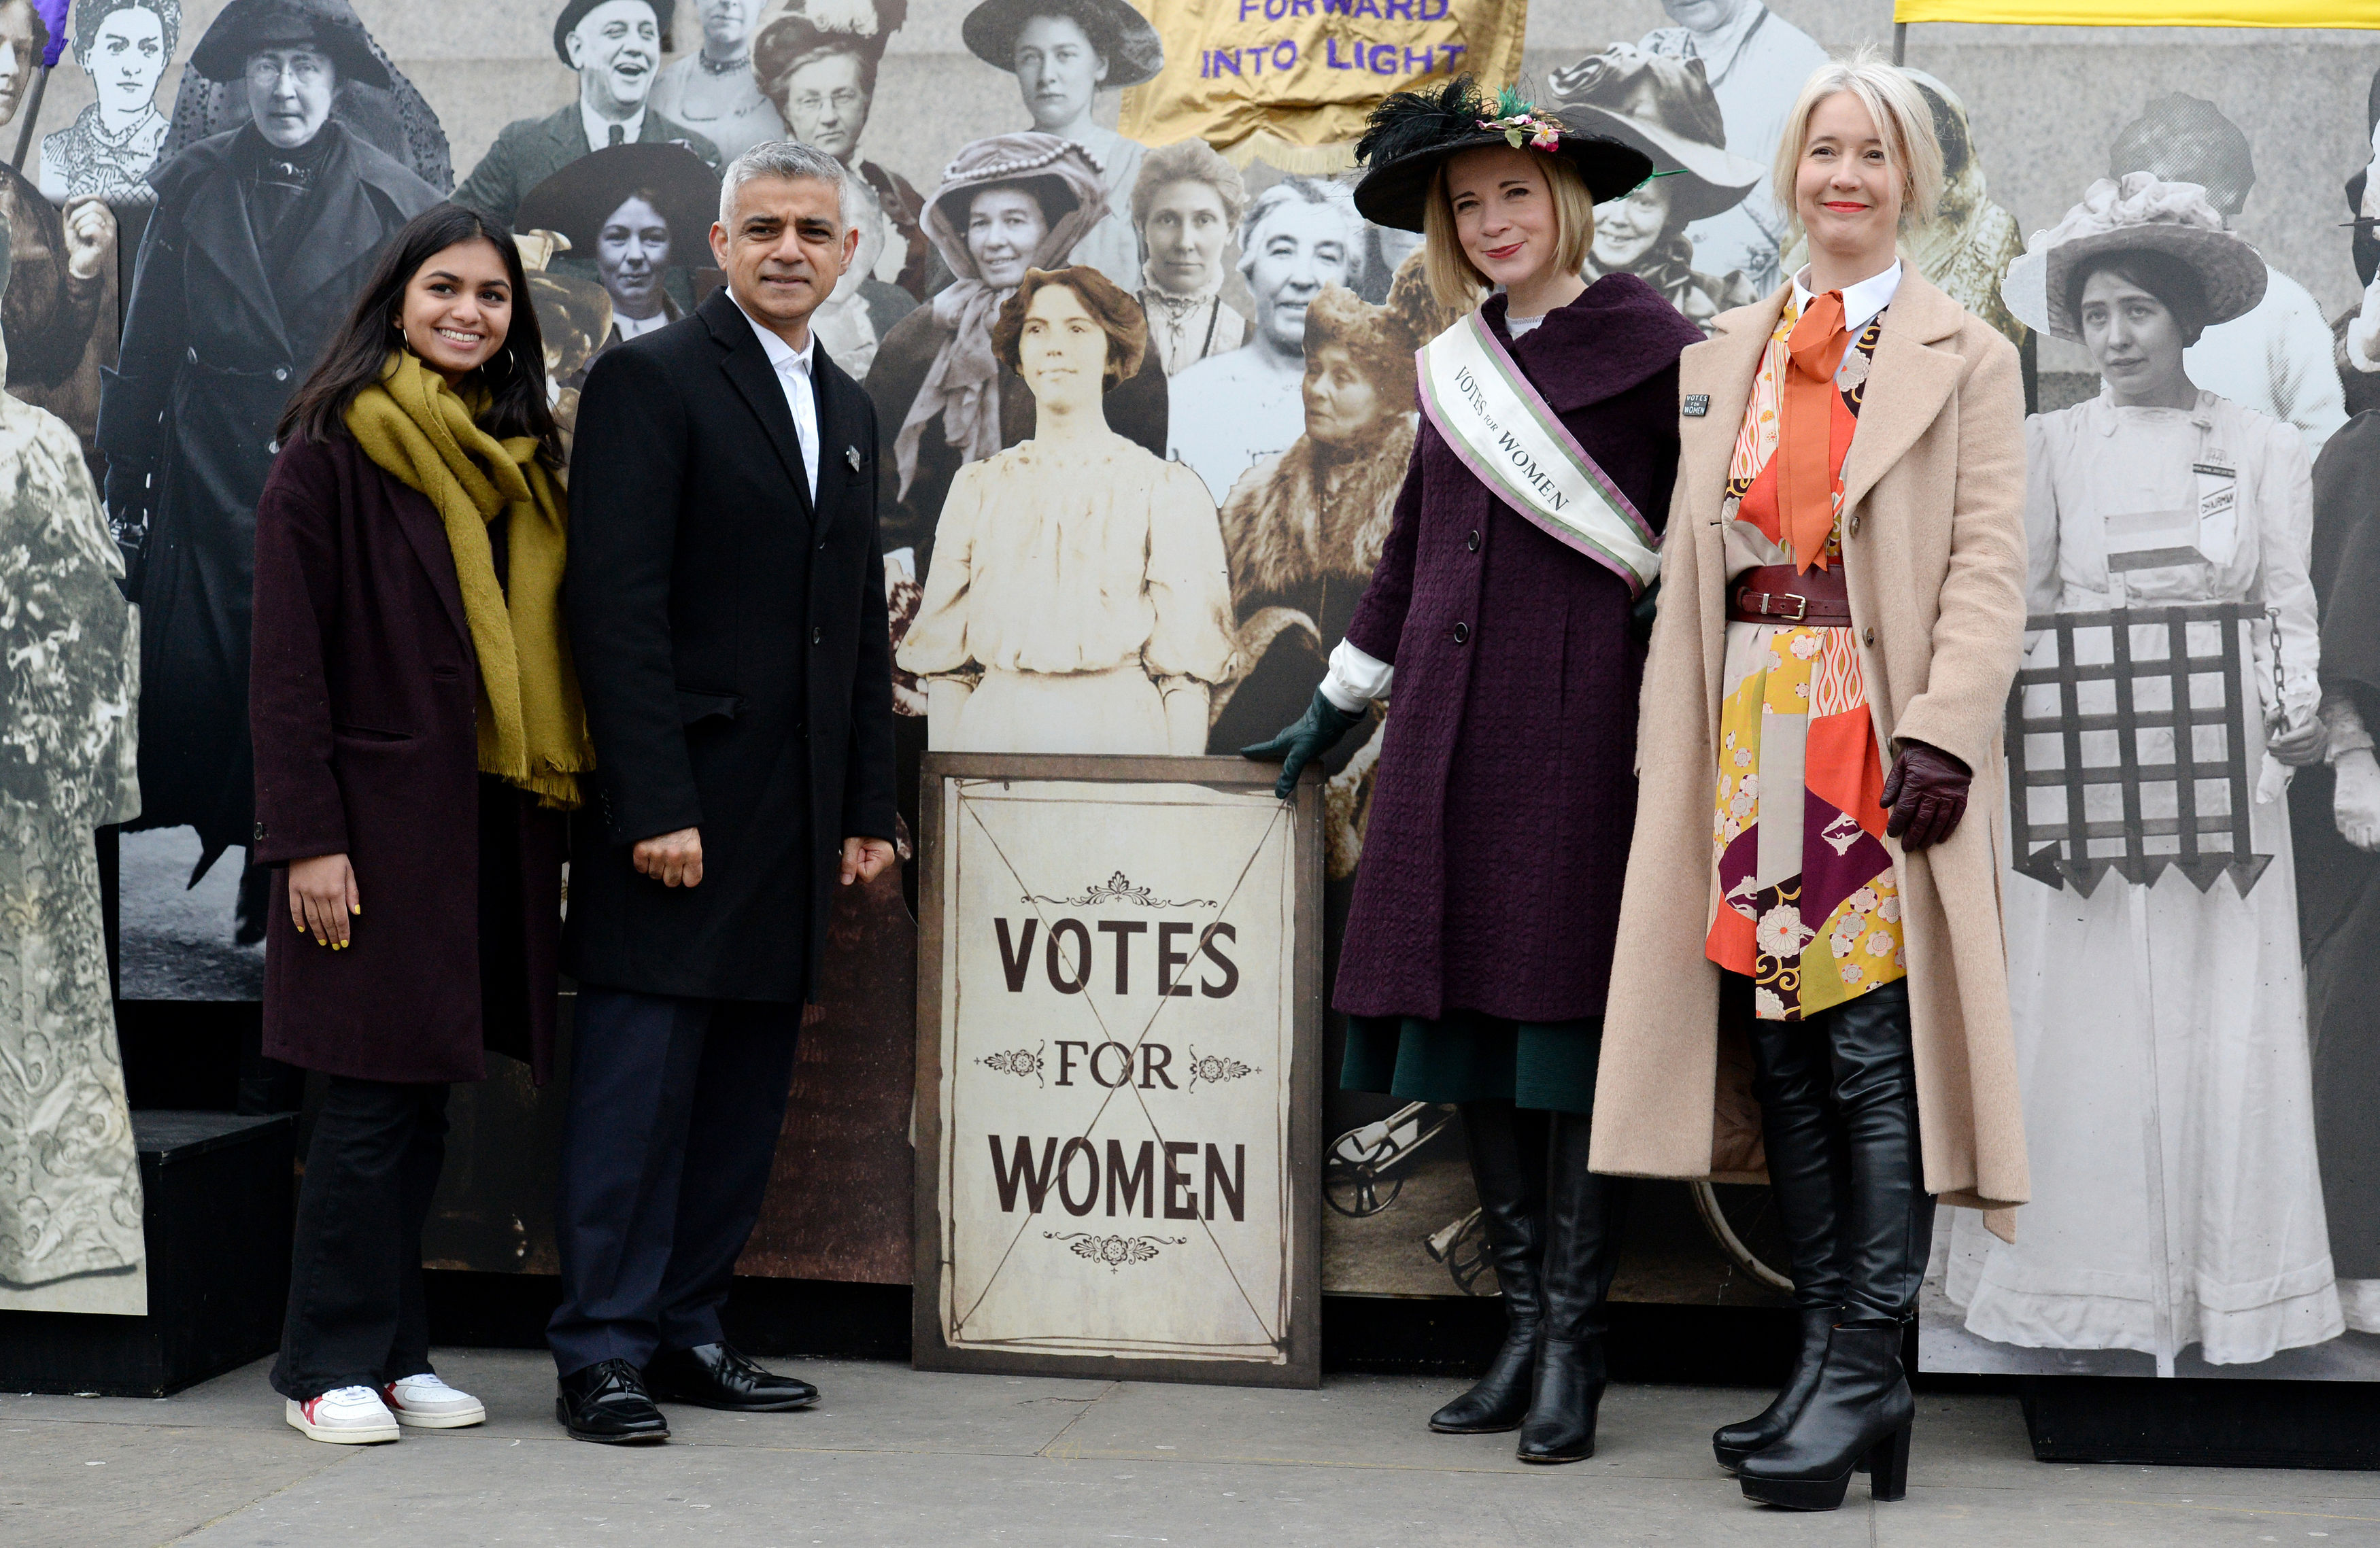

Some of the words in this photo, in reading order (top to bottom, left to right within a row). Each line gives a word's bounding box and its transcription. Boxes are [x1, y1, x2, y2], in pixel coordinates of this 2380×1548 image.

[1239, 0, 1449, 21] FORWARD
[1201, 39, 1297, 78] INTO
[1327, 37, 1467, 75] LIGHT
[1684, 407, 1705, 415] WOMEN
[1455, 366, 1486, 416] VOTES
[1483, 413, 1498, 432] FOR
[1497, 430, 1570, 512] WOMEN
[993, 917, 1240, 999] VOTES
[1055, 1040, 1178, 1090] FOR
[988, 1134, 1246, 1223] WOMEN
